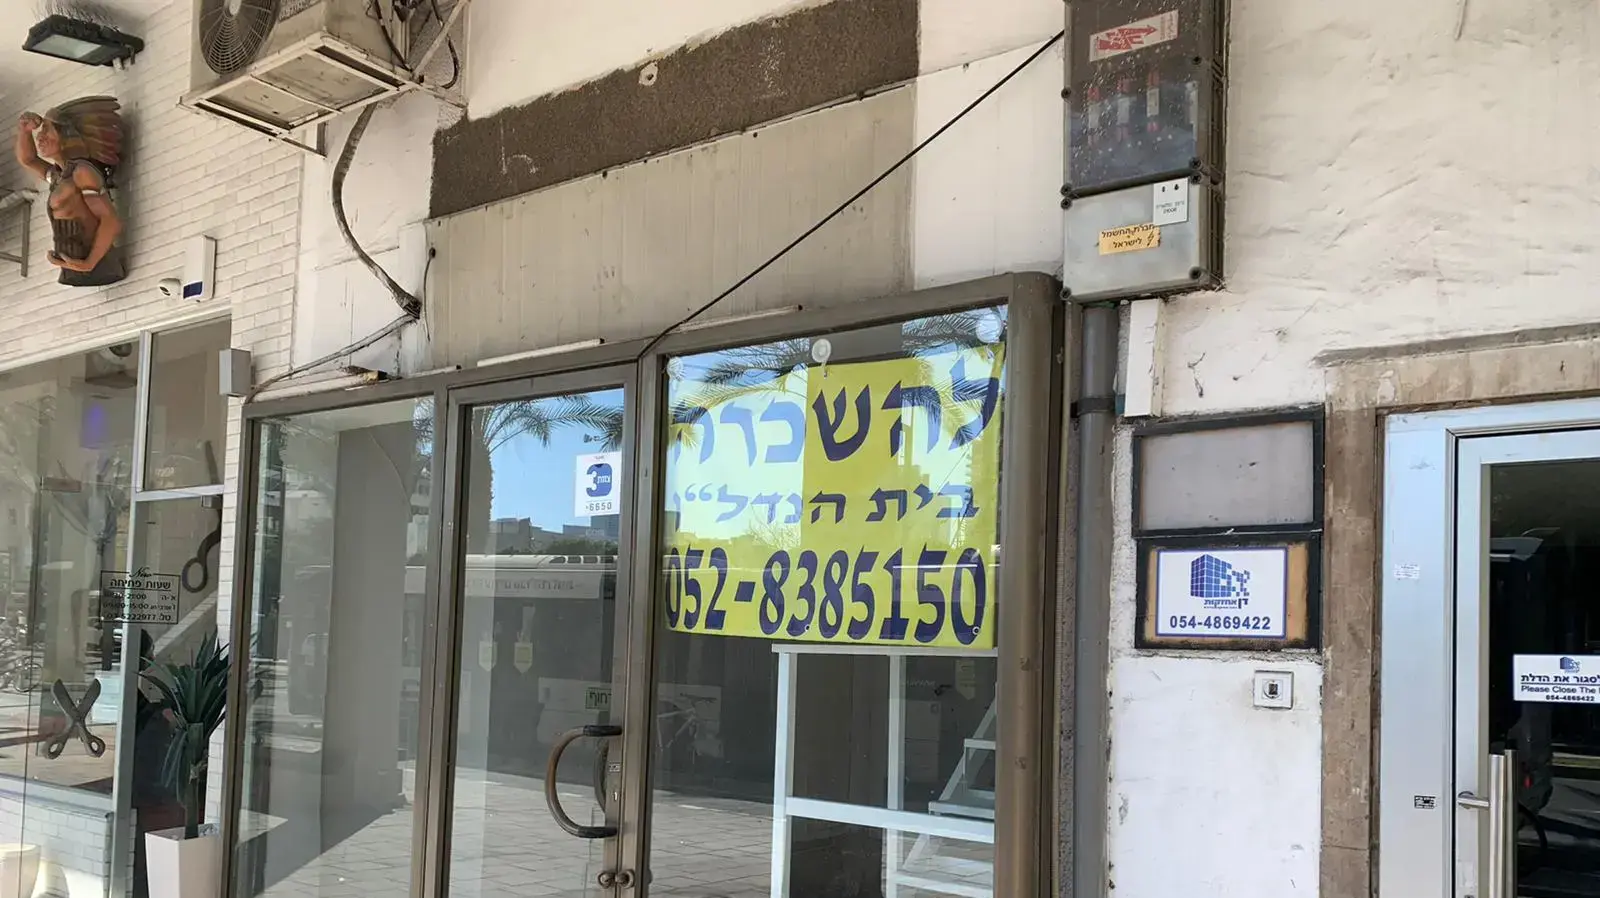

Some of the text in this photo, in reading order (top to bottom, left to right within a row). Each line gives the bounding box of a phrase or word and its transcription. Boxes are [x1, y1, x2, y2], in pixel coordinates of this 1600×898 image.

[1113, 238, 1142, 248] לישראל
[671, 355, 1000, 467] להשכרה
[866, 482, 980, 521] בית
[110, 578, 171, 589] שעות פתיחה
[665, 544, 986, 645] 052-8385150
[1169, 615, 1271, 630] 054-4869422
[1520, 673, 1550, 682] הדלת
[1554, 674, 1570, 682] את
[1521, 685, 1550, 693] Please
[1552, 686, 1577, 694] Close
